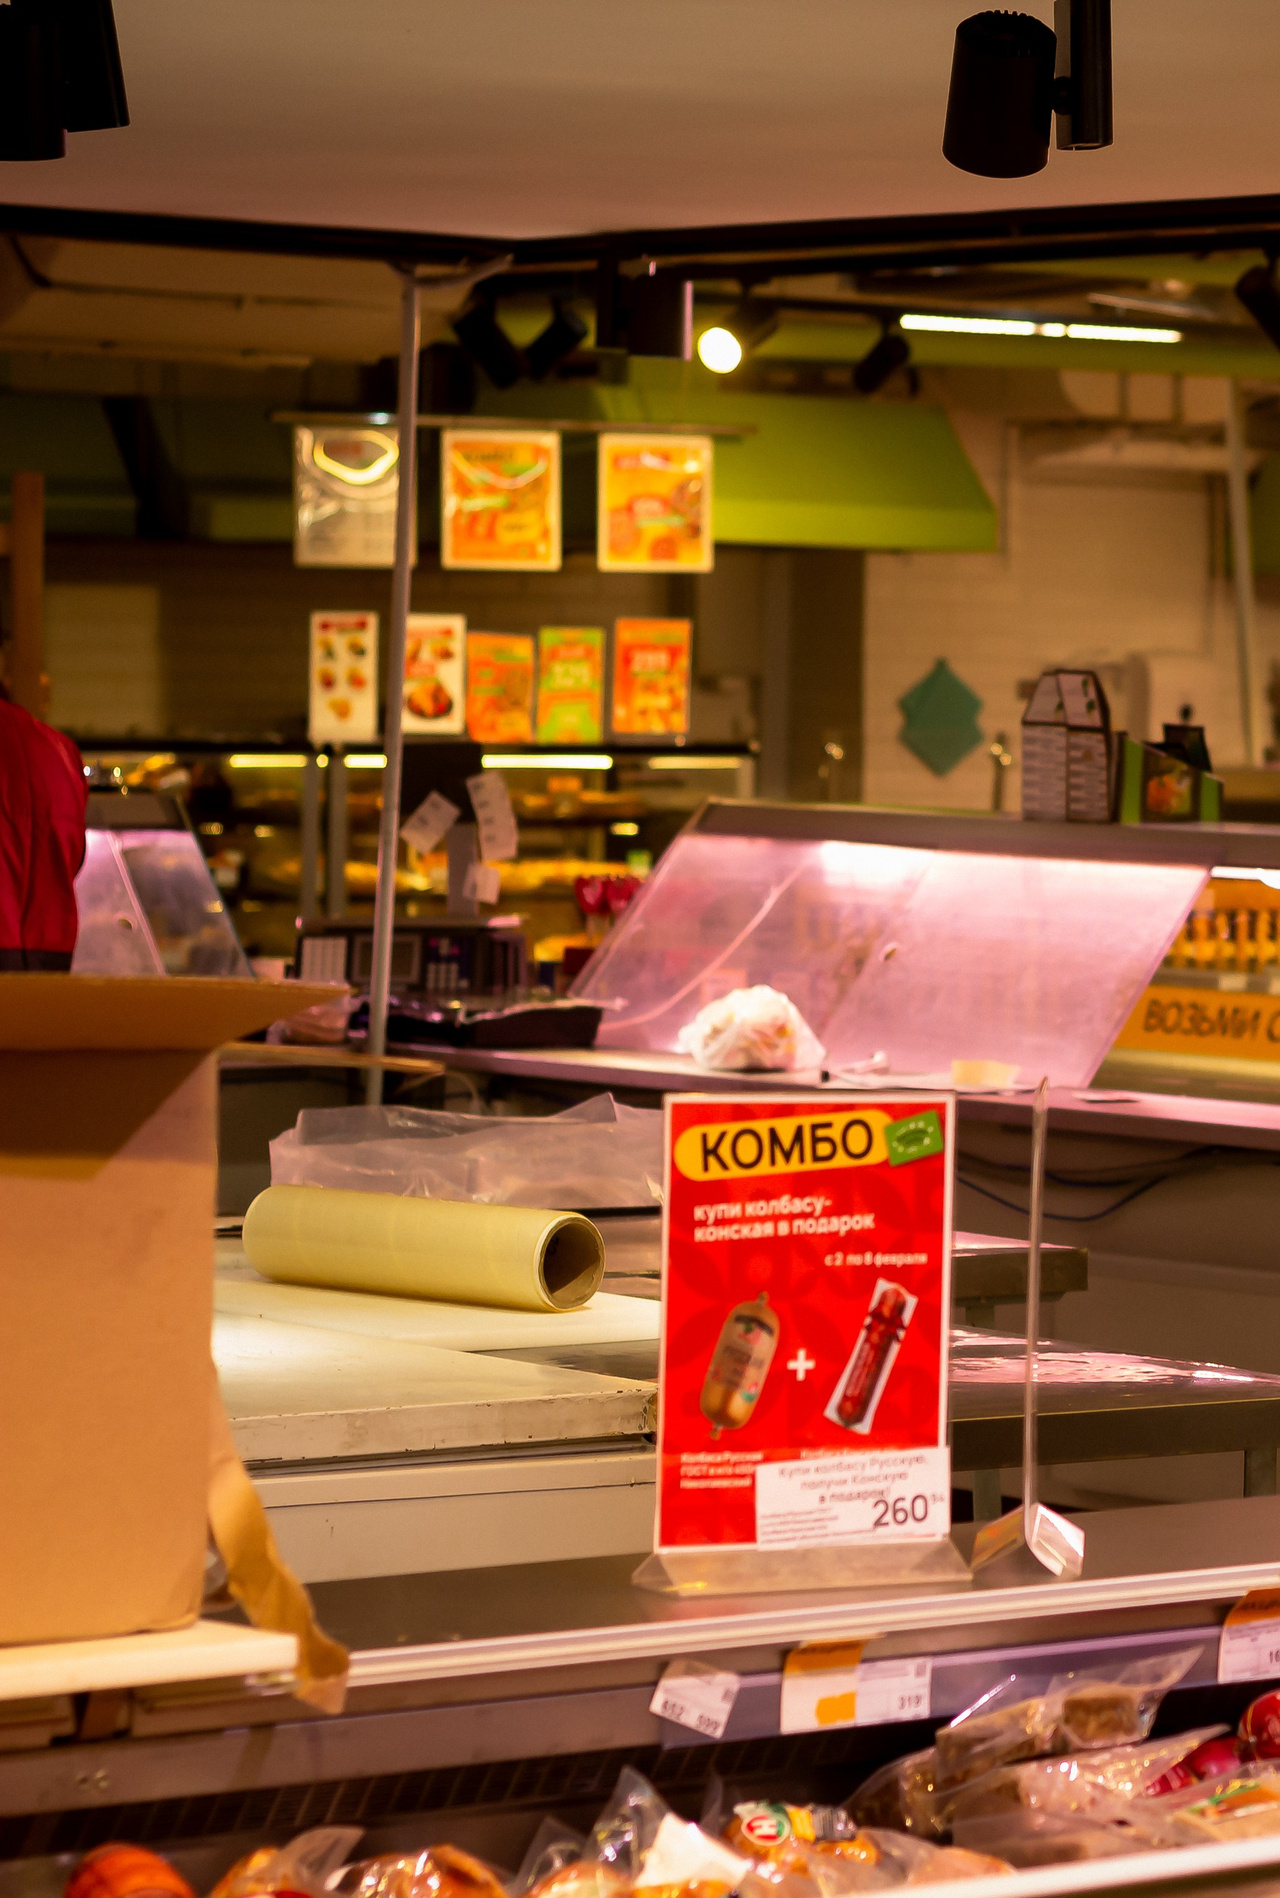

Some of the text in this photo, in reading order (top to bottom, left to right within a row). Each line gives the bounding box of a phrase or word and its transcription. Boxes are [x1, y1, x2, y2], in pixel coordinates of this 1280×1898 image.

[701, 1119, 873, 1173] КОМБО
[694, 1194, 832, 1225] купи колбасу-
[694, 1212, 876, 1243] конская в подарок
[872, 1494, 928, 1528] 260
